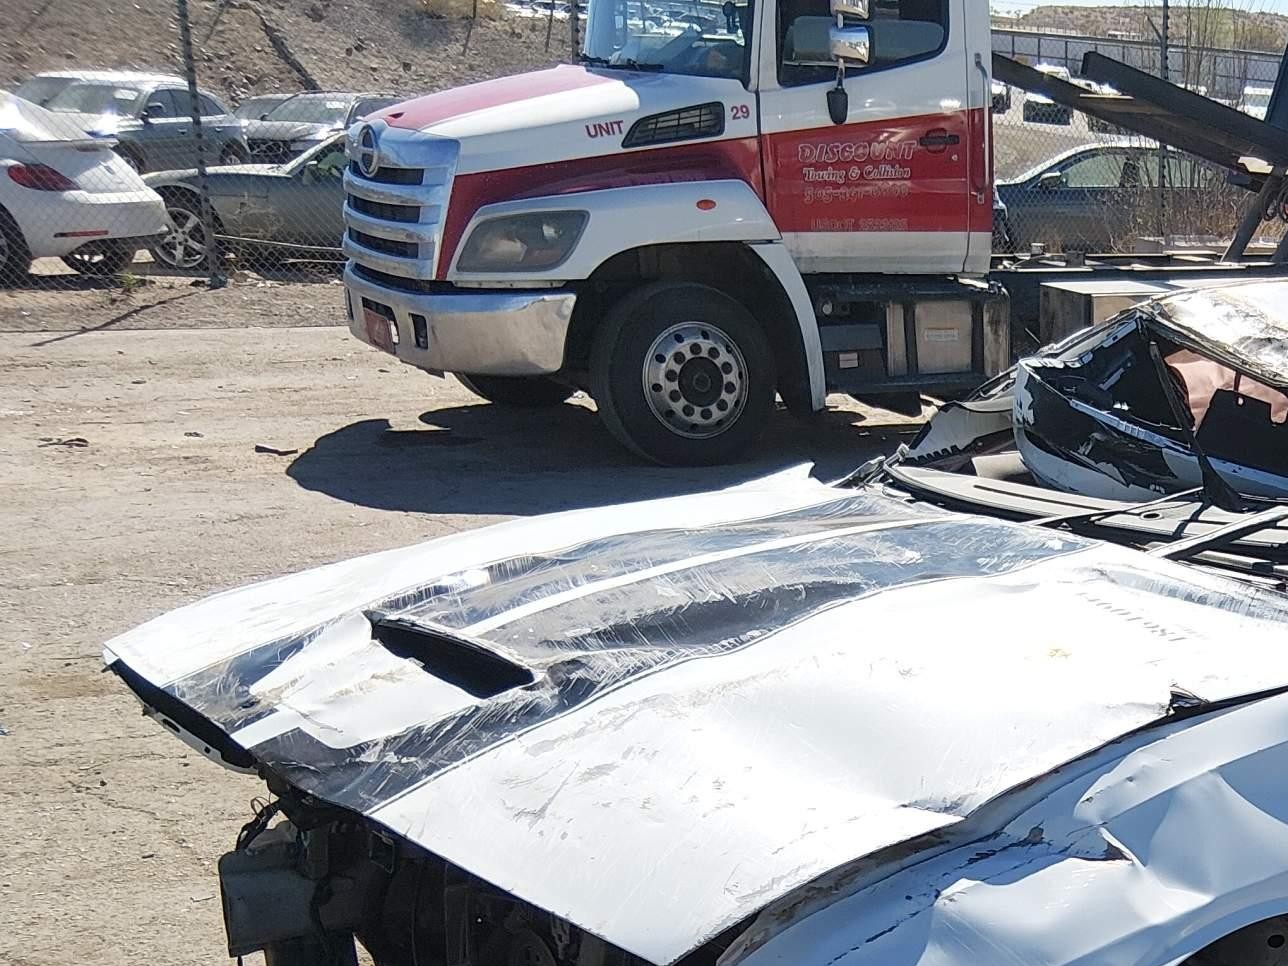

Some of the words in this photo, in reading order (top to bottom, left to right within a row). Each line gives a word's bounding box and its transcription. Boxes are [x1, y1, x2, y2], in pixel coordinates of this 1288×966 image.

[585, 120, 624, 138] UNIT
[730, 104, 750, 120] 29
[798, 140, 918, 163] DISCOUNT
[802, 167, 846, 183] Towing
[848, 166, 861, 181] &
[863, 164, 911, 180] Collision
